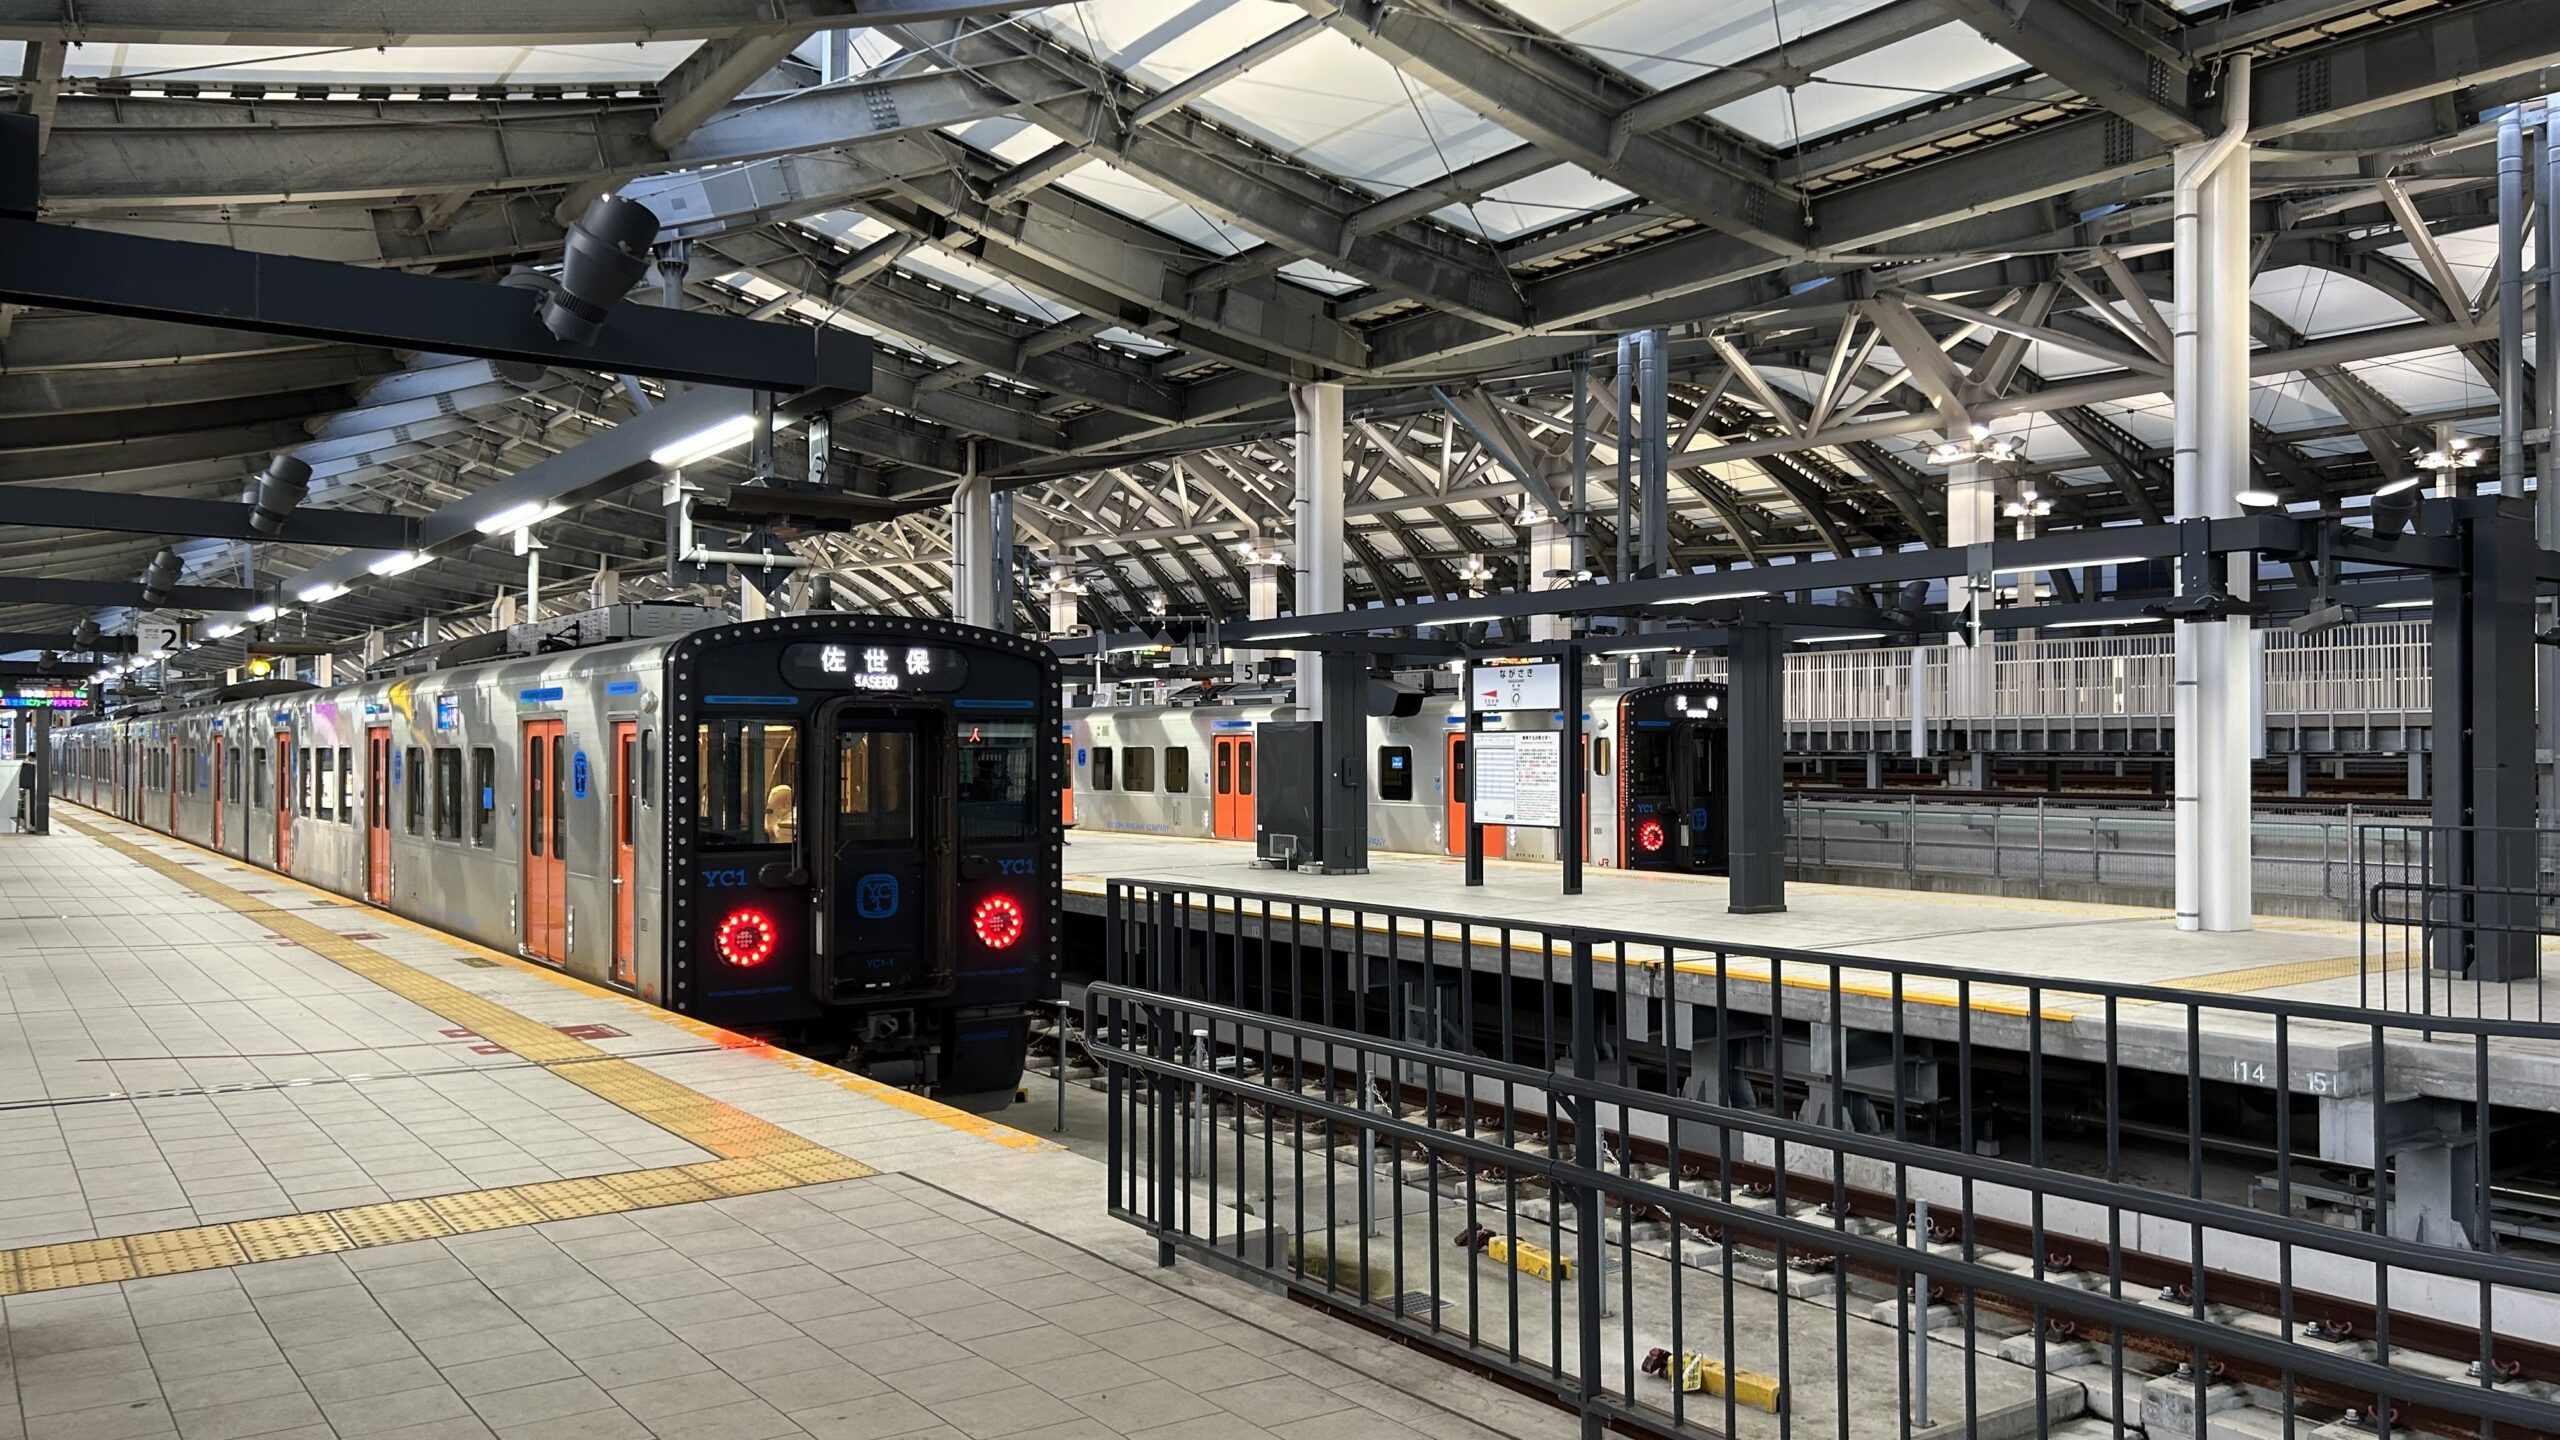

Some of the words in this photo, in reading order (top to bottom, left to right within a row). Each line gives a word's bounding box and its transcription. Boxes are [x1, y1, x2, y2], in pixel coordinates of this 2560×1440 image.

[160, 628, 177, 650] 2
[820, 645, 931, 675] 佐世保
[1244, 664, 1254, 680] 5
[1499, 668, 1533, 679] ながさき
[79, 680, 89, 690] 2
[854, 673, 899, 690] SASEBO
[996, 858, 1036, 875] YC1
[1598, 858, 1610, 867] JR
[701, 869, 747, 887] YC1
